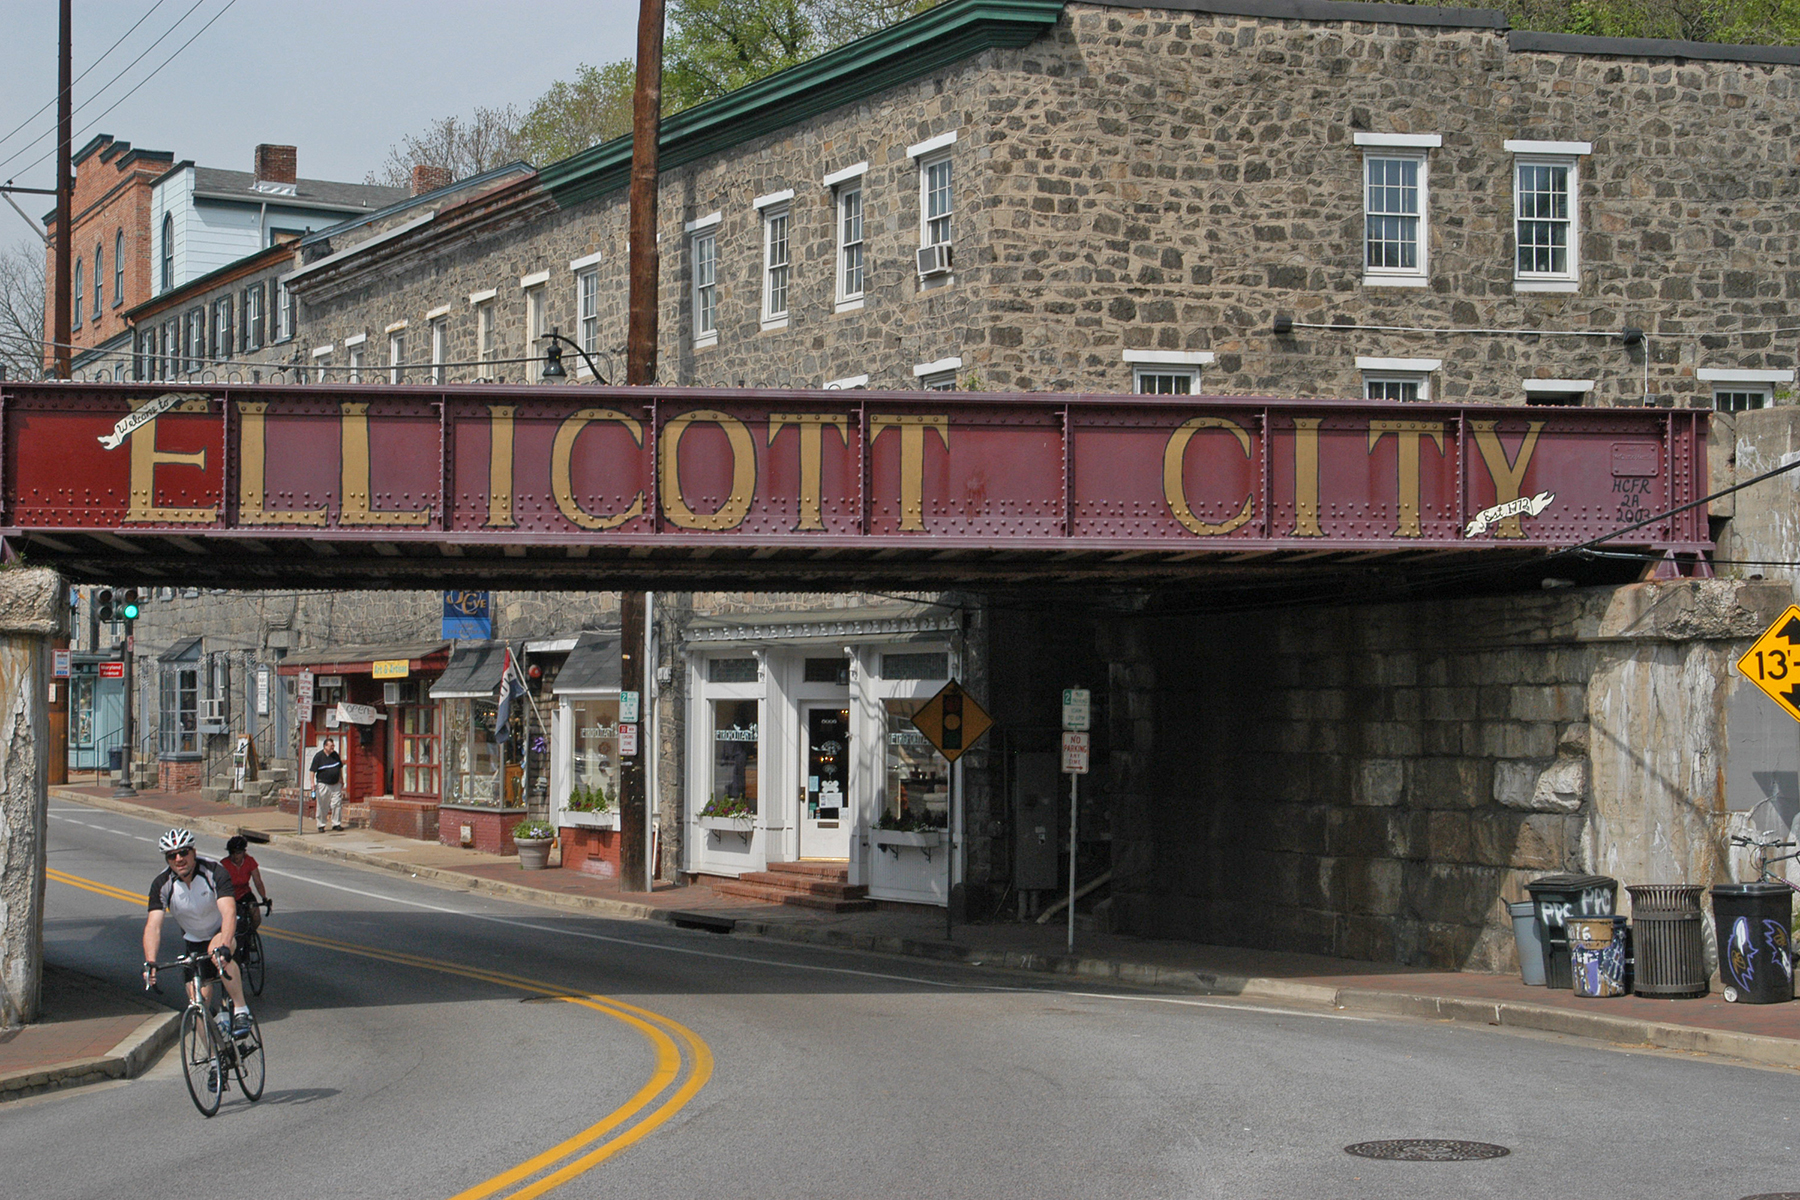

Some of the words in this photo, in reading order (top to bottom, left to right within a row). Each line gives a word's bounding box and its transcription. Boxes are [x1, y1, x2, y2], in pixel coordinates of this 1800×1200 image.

[116, 407, 159, 434] Welcome
[158, 398, 170, 410] to
[118, 398, 951, 532] ELLICOTT
[1161, 415, 1548, 539] CITY
[1612, 478, 1652, 495] HCFR
[1507, 498, 1530, 514] 1772
[1620, 494, 1640, 508] 2A
[1070, 736, 1081, 744] NO
[1063, 744, 1087, 754] PARKING
